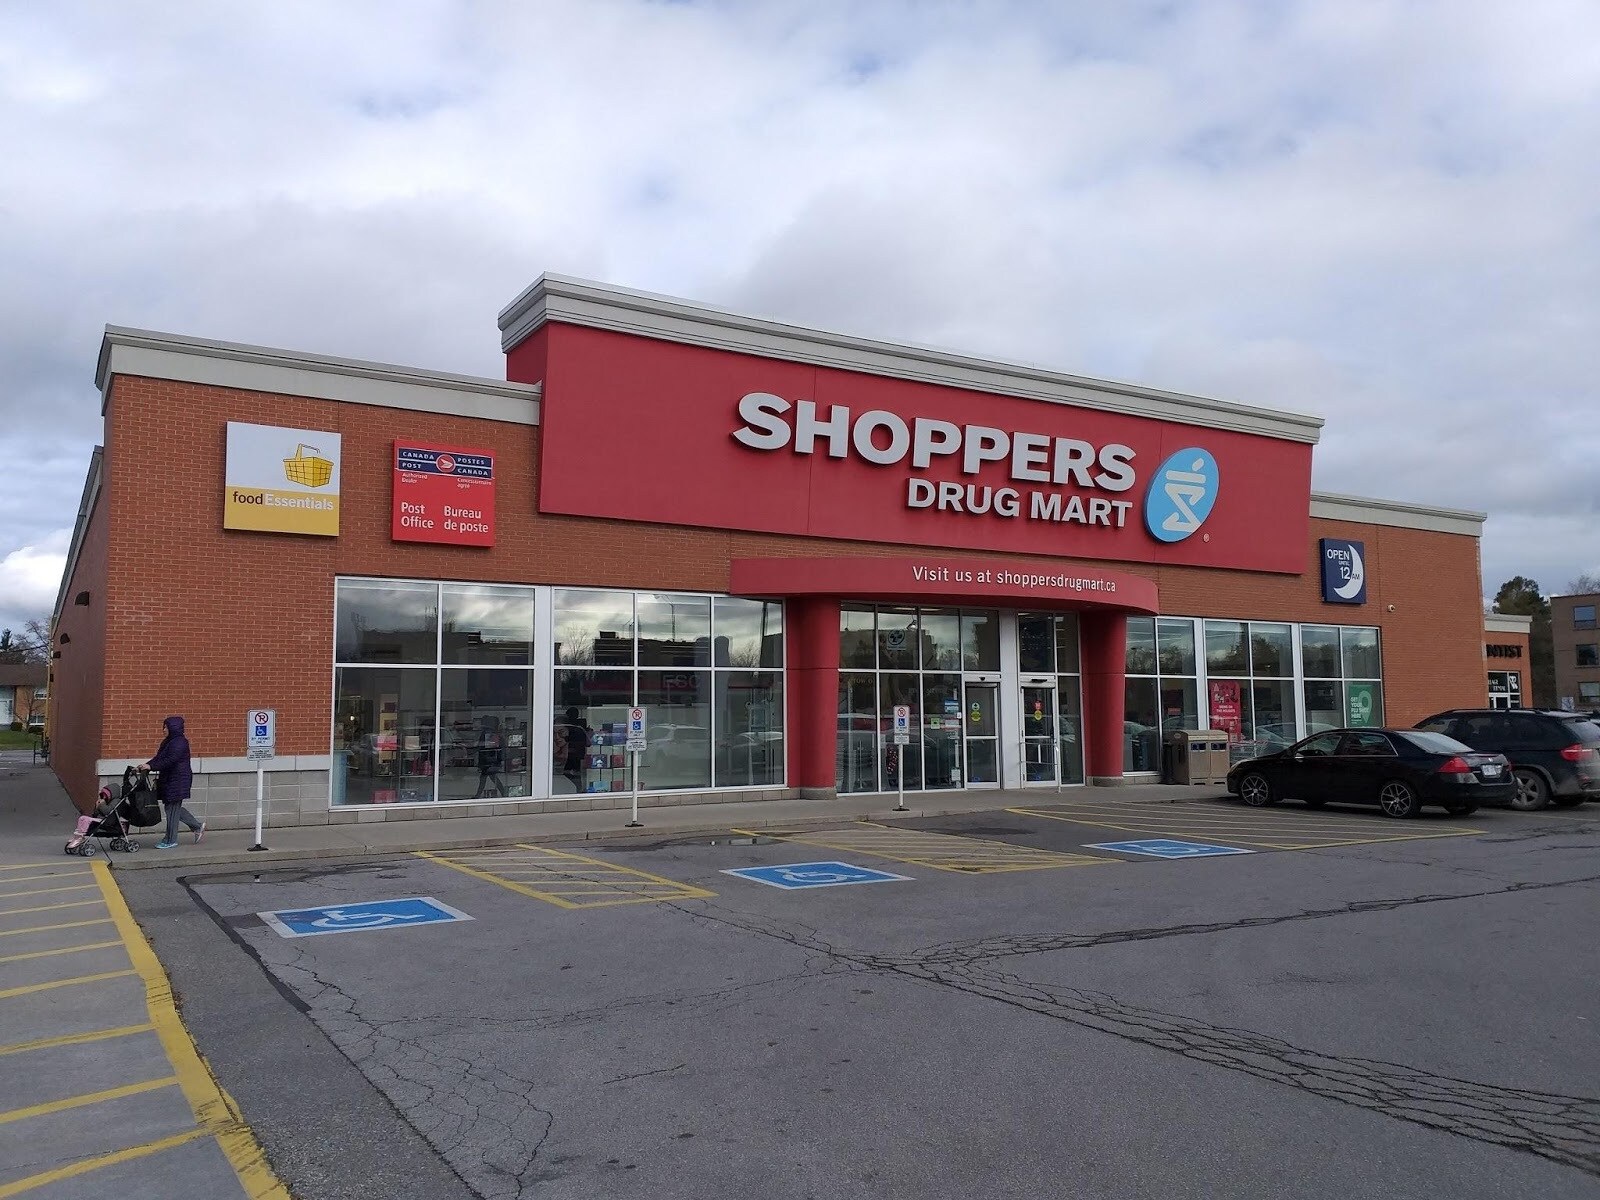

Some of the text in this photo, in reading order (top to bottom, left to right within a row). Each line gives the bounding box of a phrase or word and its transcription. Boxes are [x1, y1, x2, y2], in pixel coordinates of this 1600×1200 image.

[732, 392, 1136, 492] SHOPPERS
[402, 451, 434, 459] CANADA
[457, 468, 488, 476] CANADA
[401, 502, 425, 514] Post
[907, 477, 1132, 528] DRUG MART
[444, 506, 481, 519] Bureau
[401, 516, 434, 529] Office
[444, 519, 489, 533] de poste
[1327, 549, 1350, 560] OPEN
[913, 566, 1116, 592] Visit us at shoppersdrugmart.ca
[1340, 566, 1351, 580] 12
